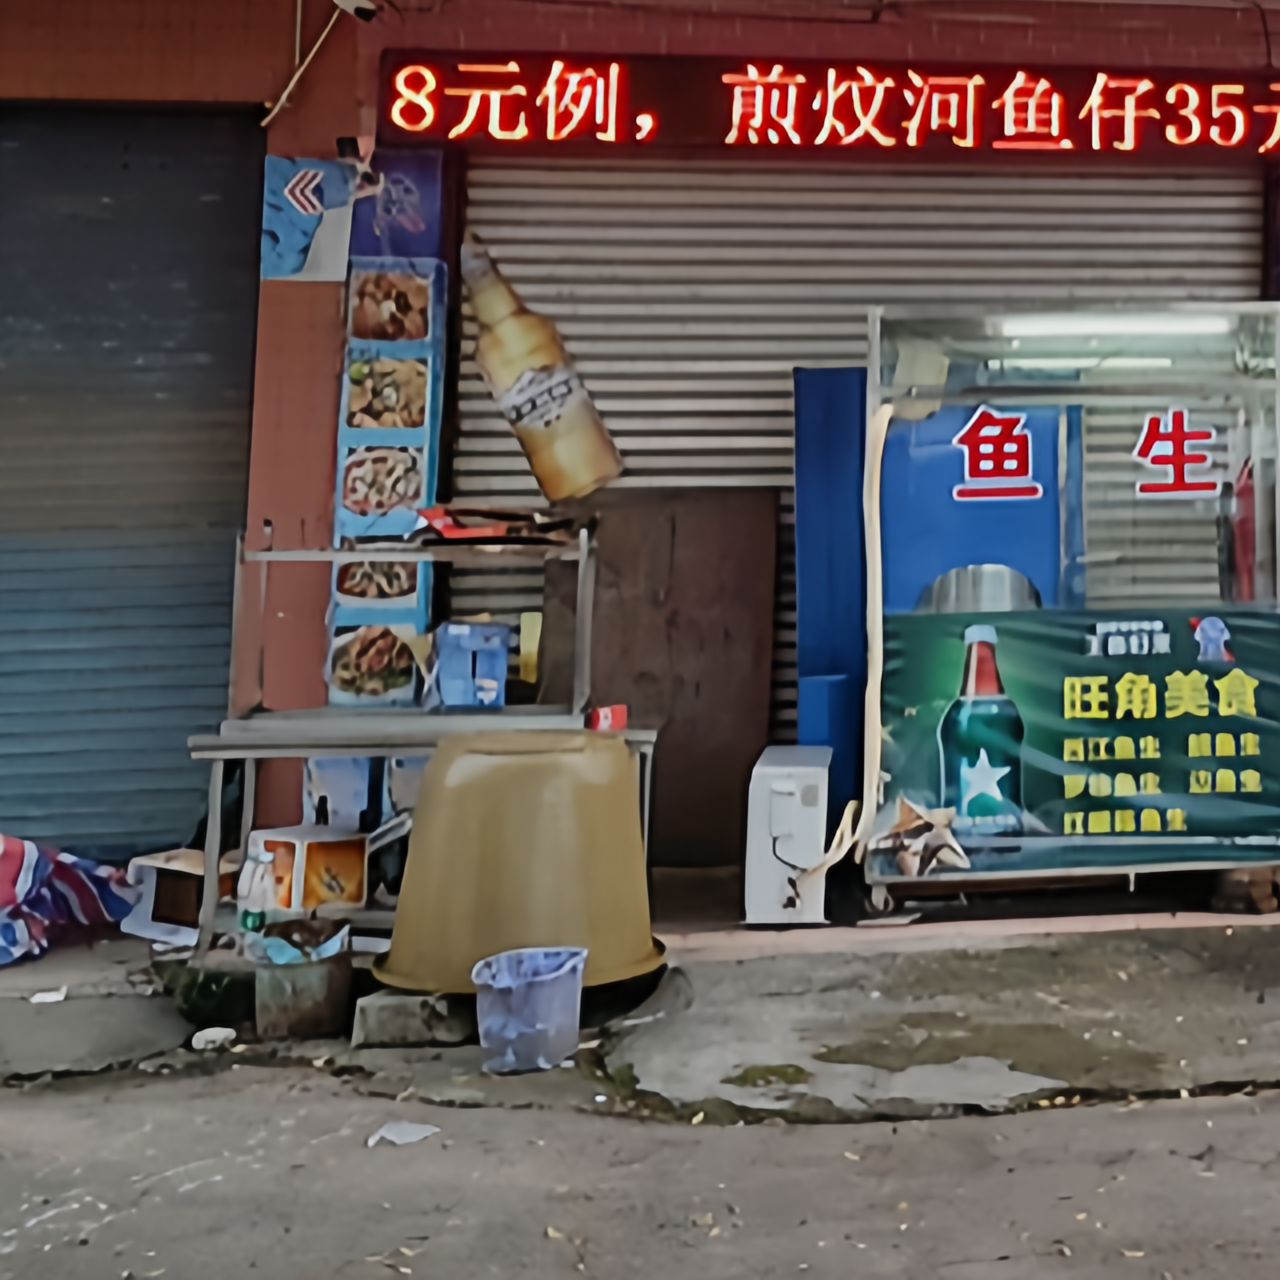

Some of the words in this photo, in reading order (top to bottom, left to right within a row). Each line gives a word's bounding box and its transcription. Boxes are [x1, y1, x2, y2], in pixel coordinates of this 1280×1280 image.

[953, 404, 1222, 502] 鱼生
[1063, 668, 1260, 720] 旺角美食
